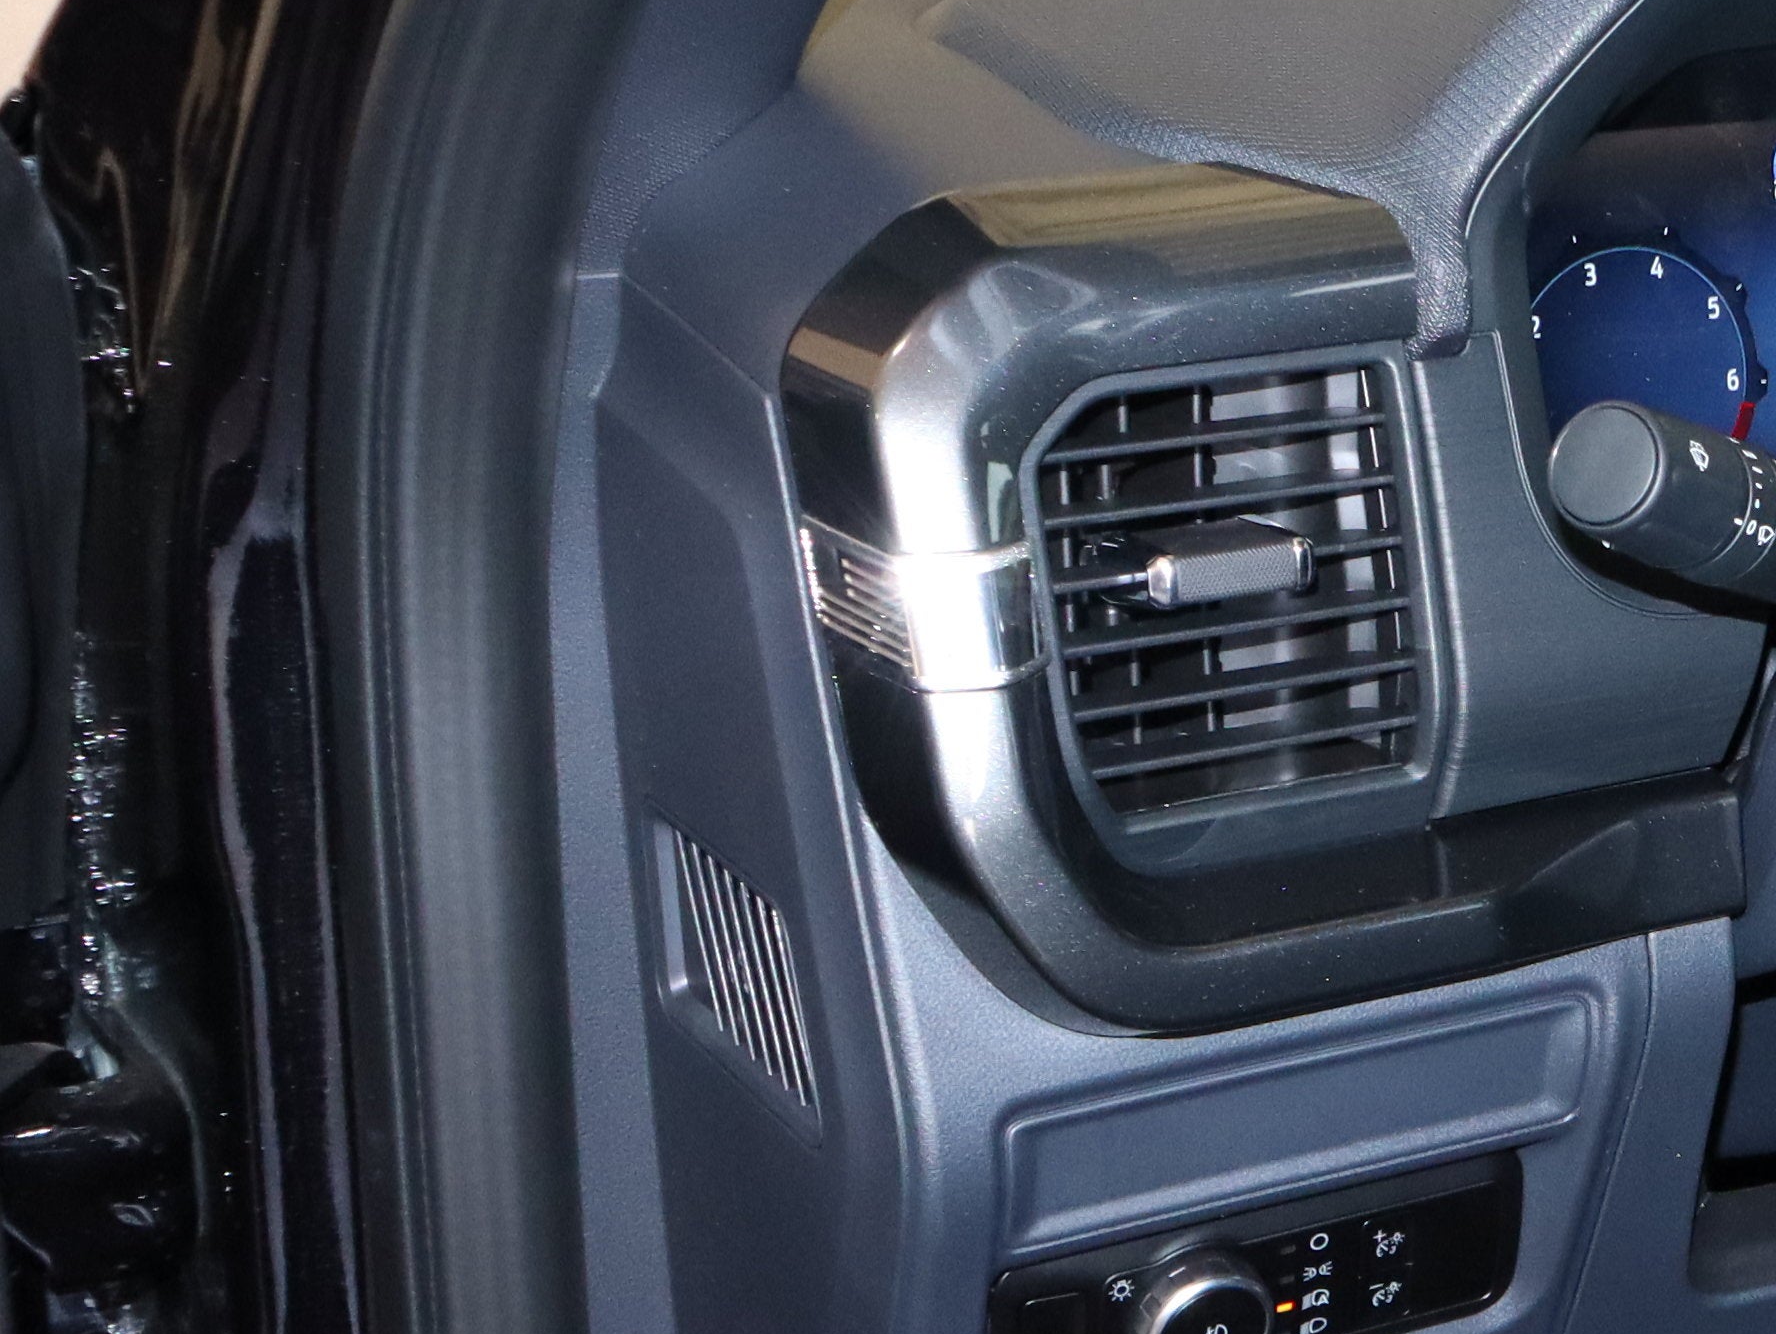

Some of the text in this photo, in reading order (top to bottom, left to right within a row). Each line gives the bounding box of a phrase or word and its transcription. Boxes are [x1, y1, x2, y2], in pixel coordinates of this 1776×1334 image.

[1583, 262, 1598, 287] 3
[1650, 255, 1664, 279] 4
[1707, 295, 1720, 320] 5
[1726, 368, 1740, 392] 6
